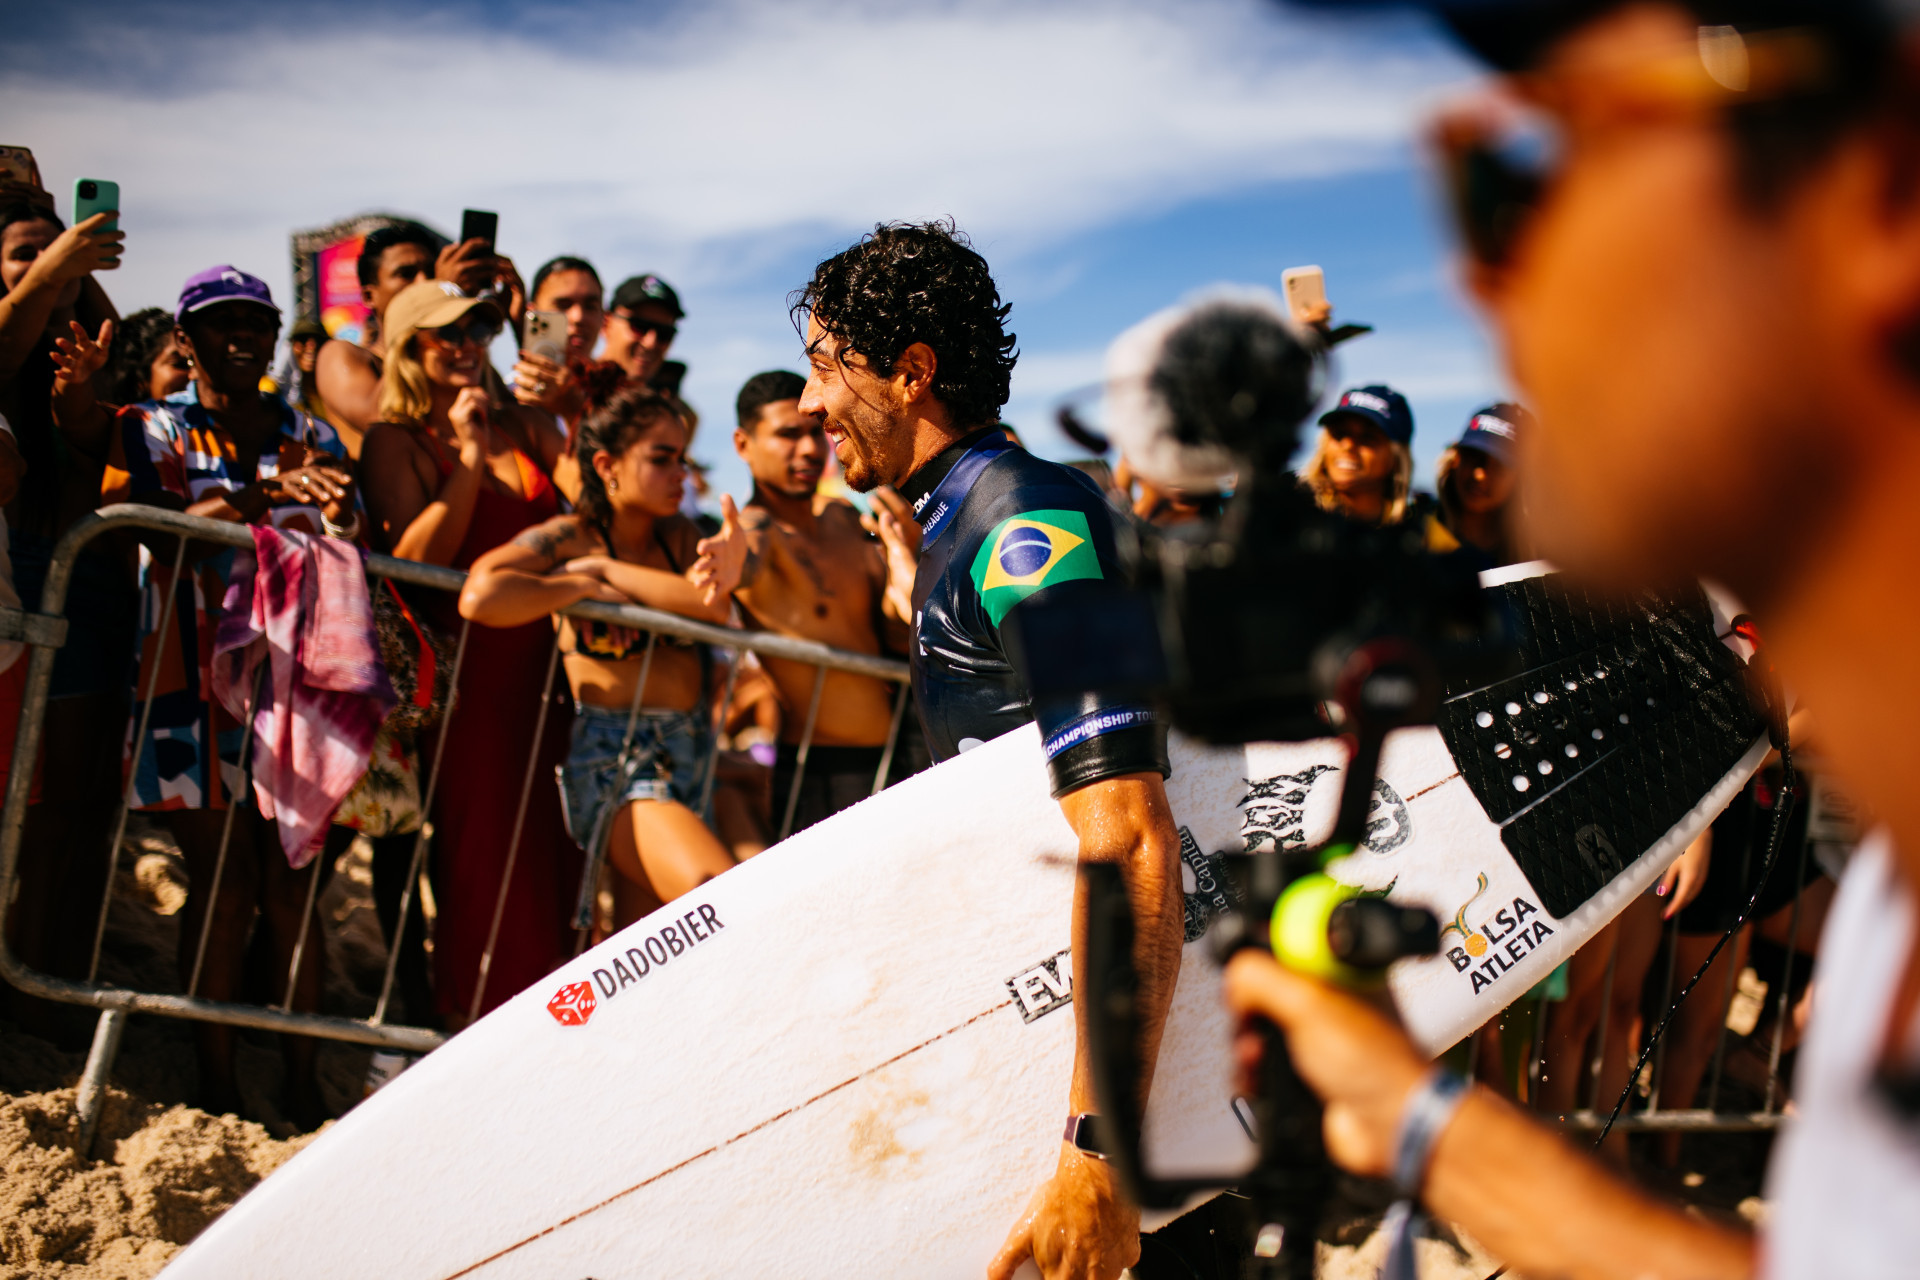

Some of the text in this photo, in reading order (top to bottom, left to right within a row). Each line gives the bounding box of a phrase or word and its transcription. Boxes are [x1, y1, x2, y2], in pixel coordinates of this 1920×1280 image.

[1047, 712, 1134, 756] CHAMPIONSHIP
[592, 903, 725, 999] DADOBIER
[1470, 920, 1554, 995] ATLETA
